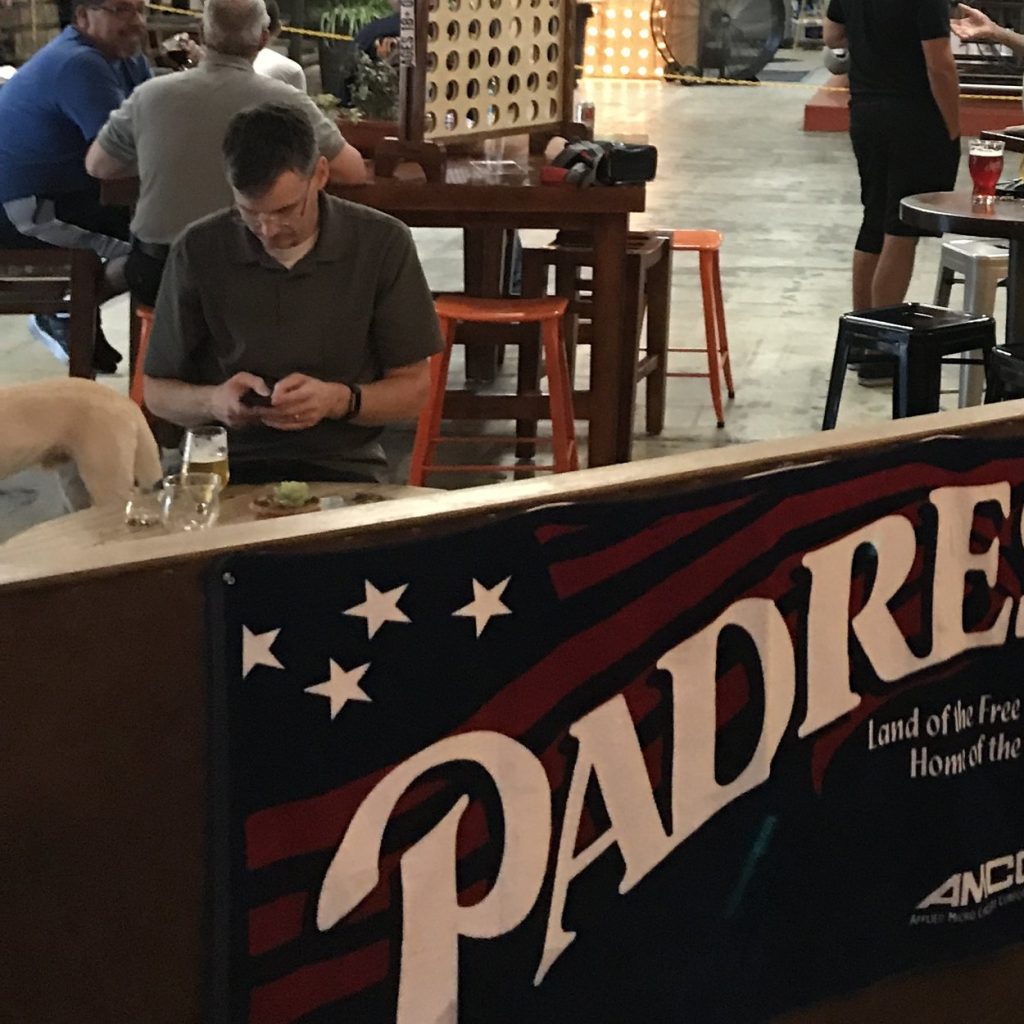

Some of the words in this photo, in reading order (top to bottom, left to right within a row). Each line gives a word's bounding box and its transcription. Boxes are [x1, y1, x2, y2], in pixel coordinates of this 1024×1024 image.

[868, 707, 919, 750] Land
[926, 704, 951, 736] of
[954, 700, 973, 733] the
[978, 694, 1021, 724] Free
[969, 734, 985, 766] of
[988, 733, 1021, 762] the
